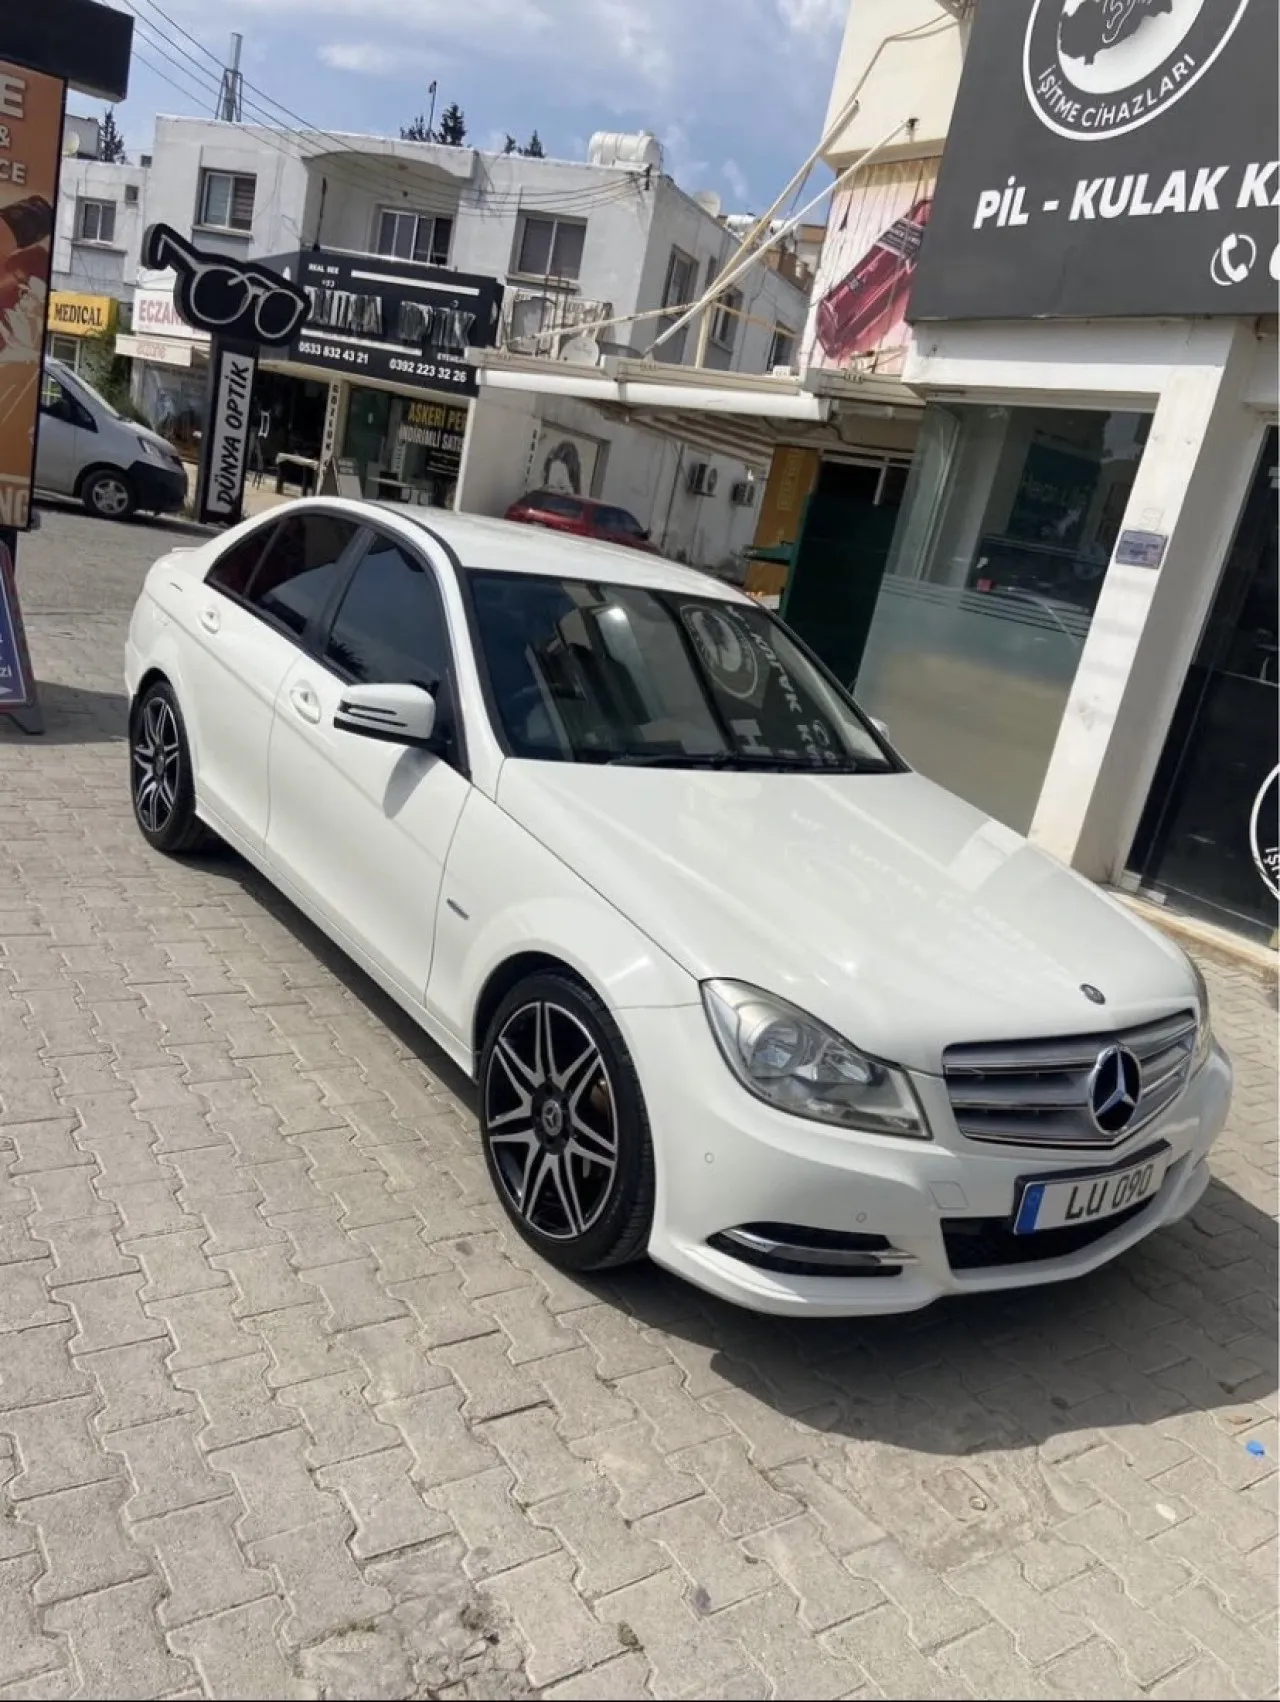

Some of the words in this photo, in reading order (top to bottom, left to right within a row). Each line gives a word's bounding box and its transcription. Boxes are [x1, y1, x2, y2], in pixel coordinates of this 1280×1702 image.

[1081, 53, 1197, 128] CİHAZLARI
[972, 175, 1029, 229] PİL
[1068, 165, 1230, 221] KULAK
[53, 303, 103, 328] MEDICAL
[138, 299, 184, 326] ECZAN
[322, 343, 342, 359] 832
[342, 347, 356, 361] 43
[356, 349, 369, 365] 21
[389, 358, 415, 373] 0392
[415, 362, 436, 377] 223
[437, 365, 452, 380] 32
[452, 369, 468, 383] 26
[223, 362, 250, 431] OPTİK
[214, 436, 241, 506] DÜNYA
[1064, 1181, 1109, 1221] LU
[1111, 1164, 1154, 1210] 090
